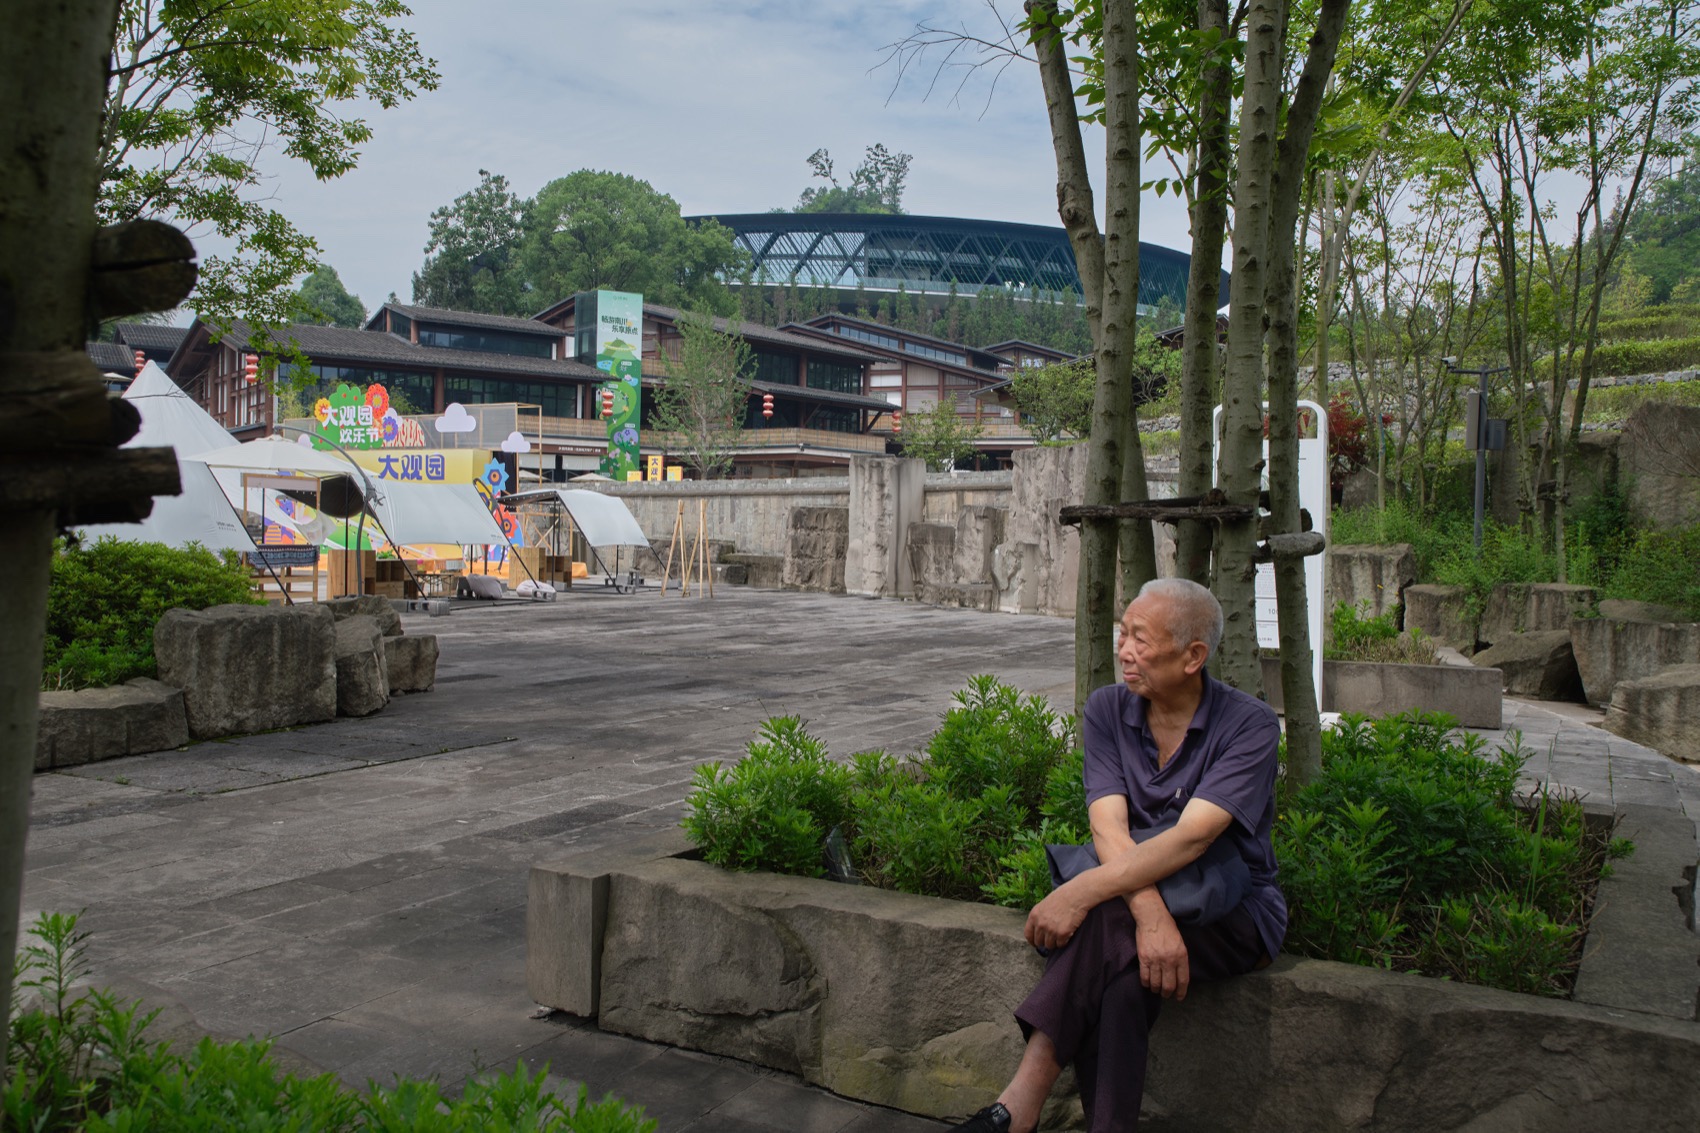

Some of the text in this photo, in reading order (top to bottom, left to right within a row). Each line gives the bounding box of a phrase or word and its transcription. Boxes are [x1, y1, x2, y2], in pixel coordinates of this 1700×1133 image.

[322, 406, 373, 426] 大观园
[340, 428, 379, 443] 欢乐节
[378, 454, 445, 480] 大观园
